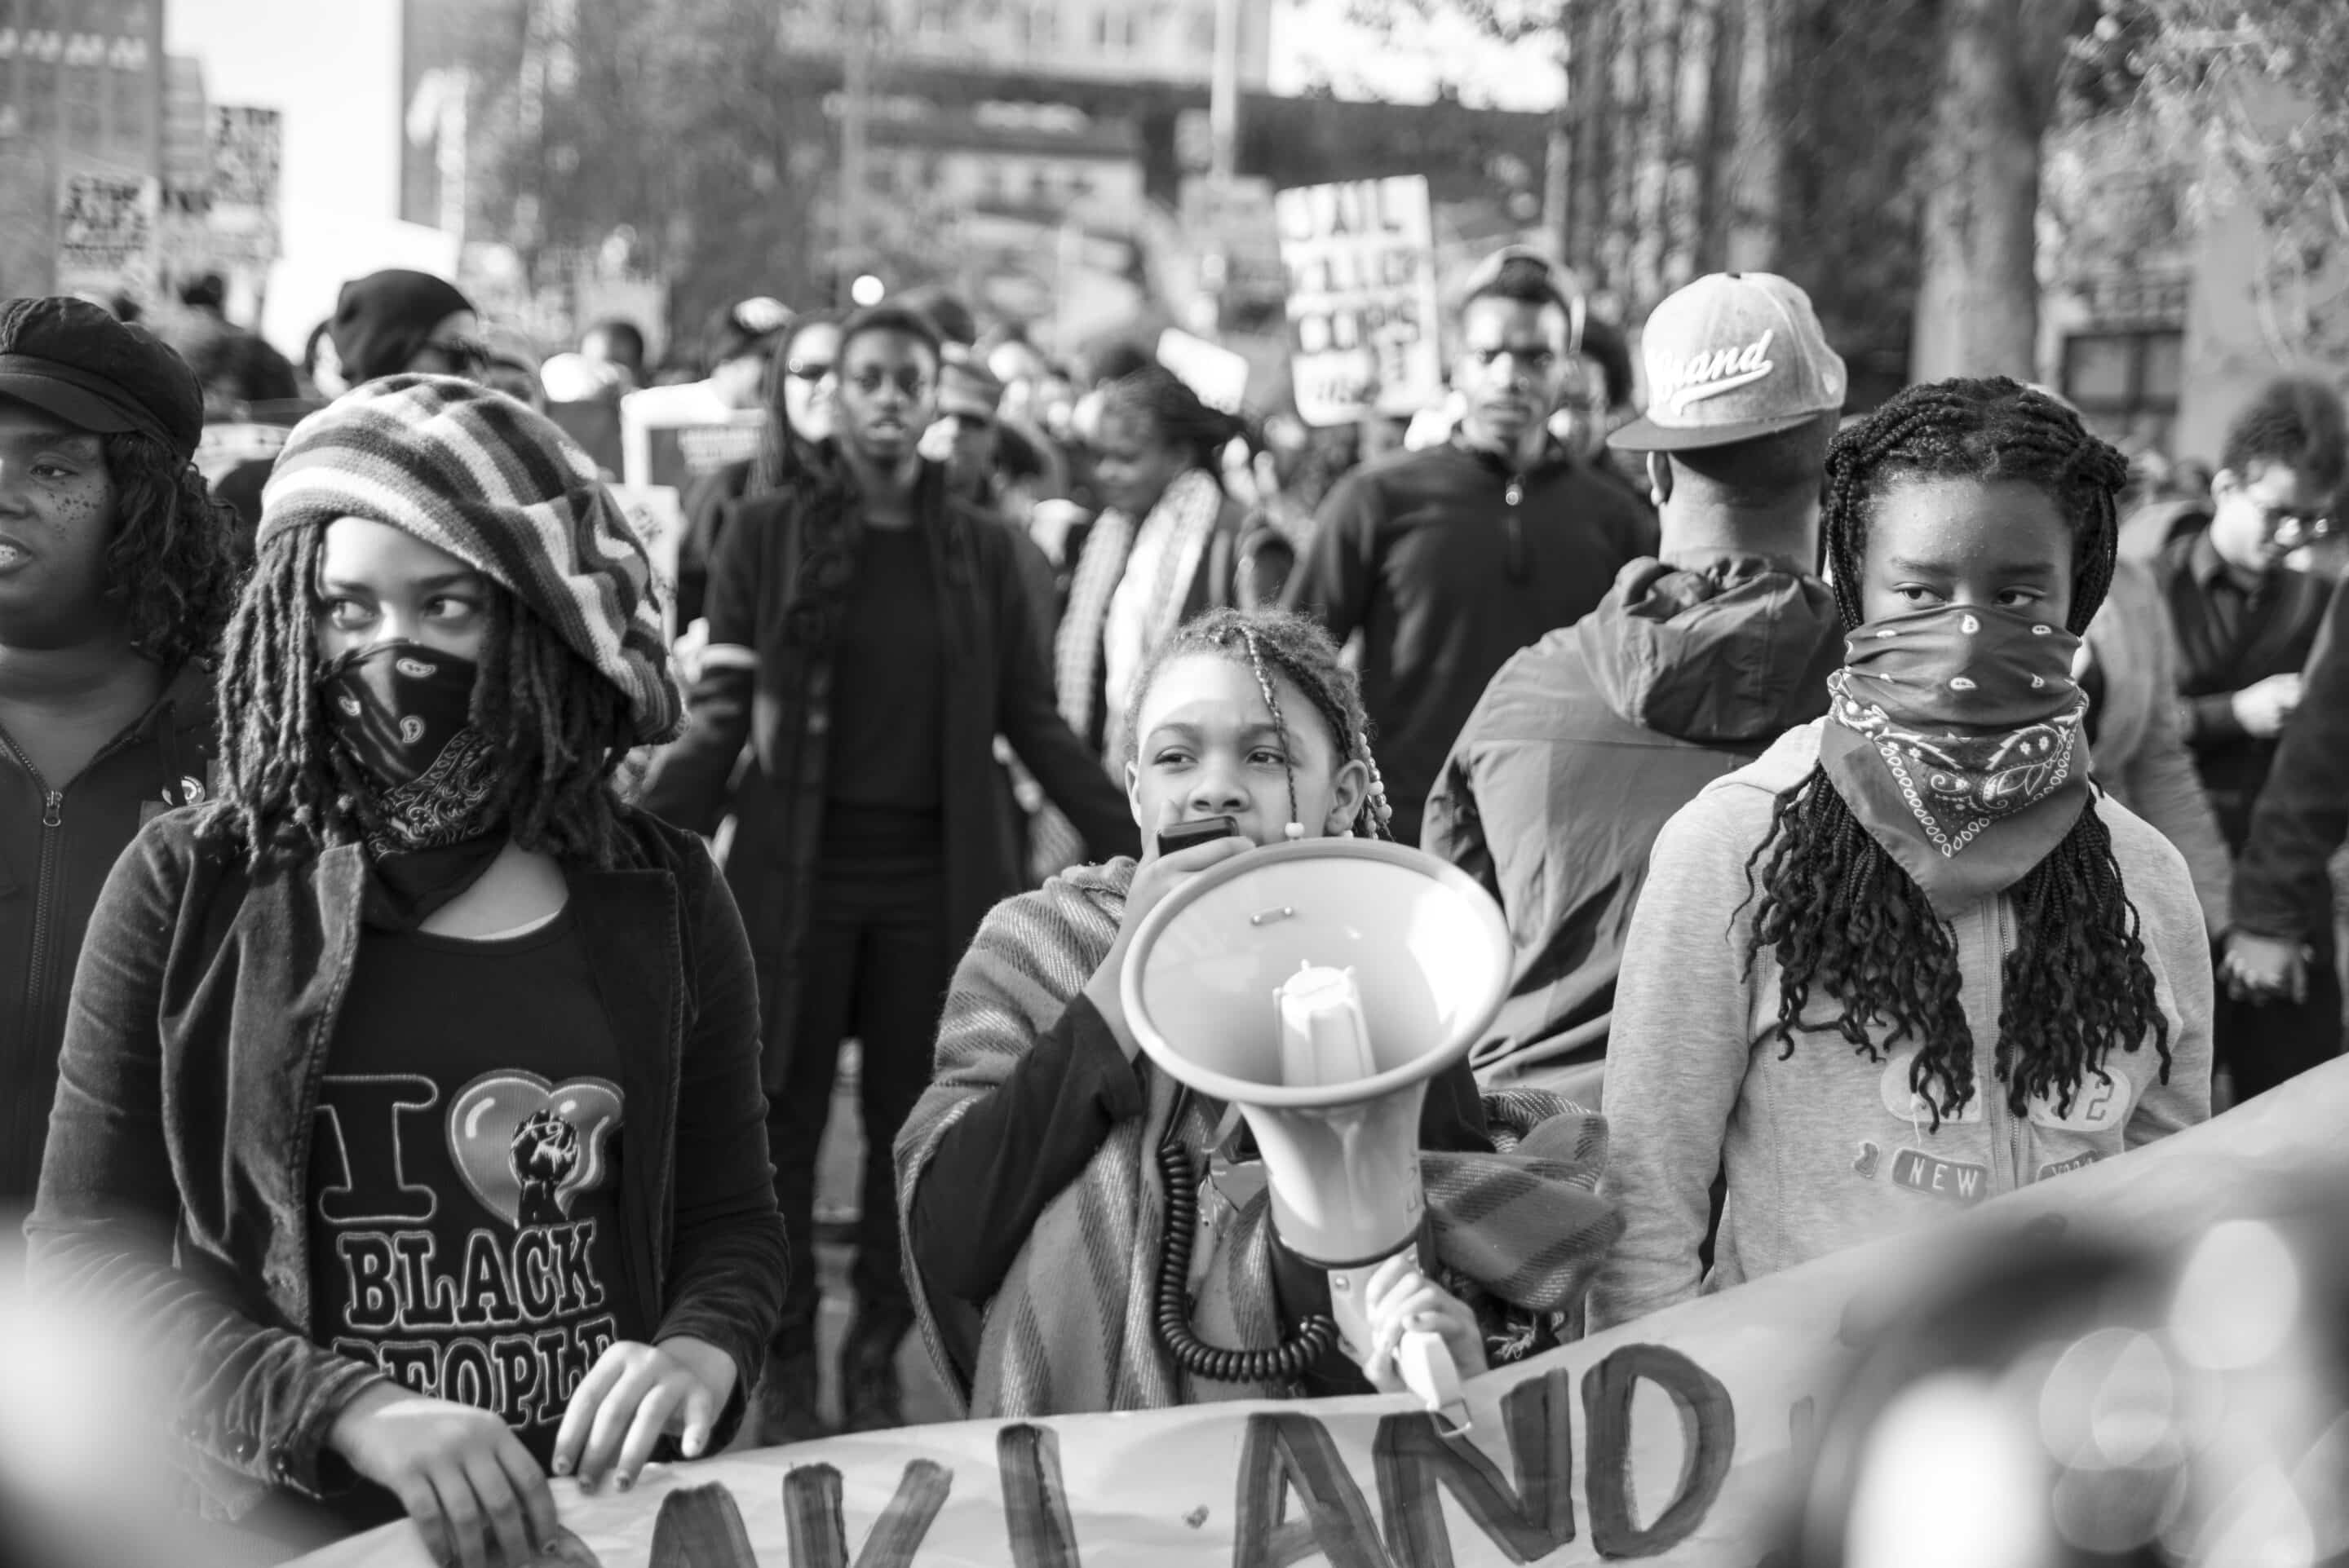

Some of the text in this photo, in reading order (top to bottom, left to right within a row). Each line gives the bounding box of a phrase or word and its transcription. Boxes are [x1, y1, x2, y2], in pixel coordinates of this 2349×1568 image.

[316, 1075, 439, 1223] I
[1909, 1155, 1979, 1199] NEW
[337, 1218, 604, 1331] BLACK
[333, 1317, 618, 1429] EOPL
